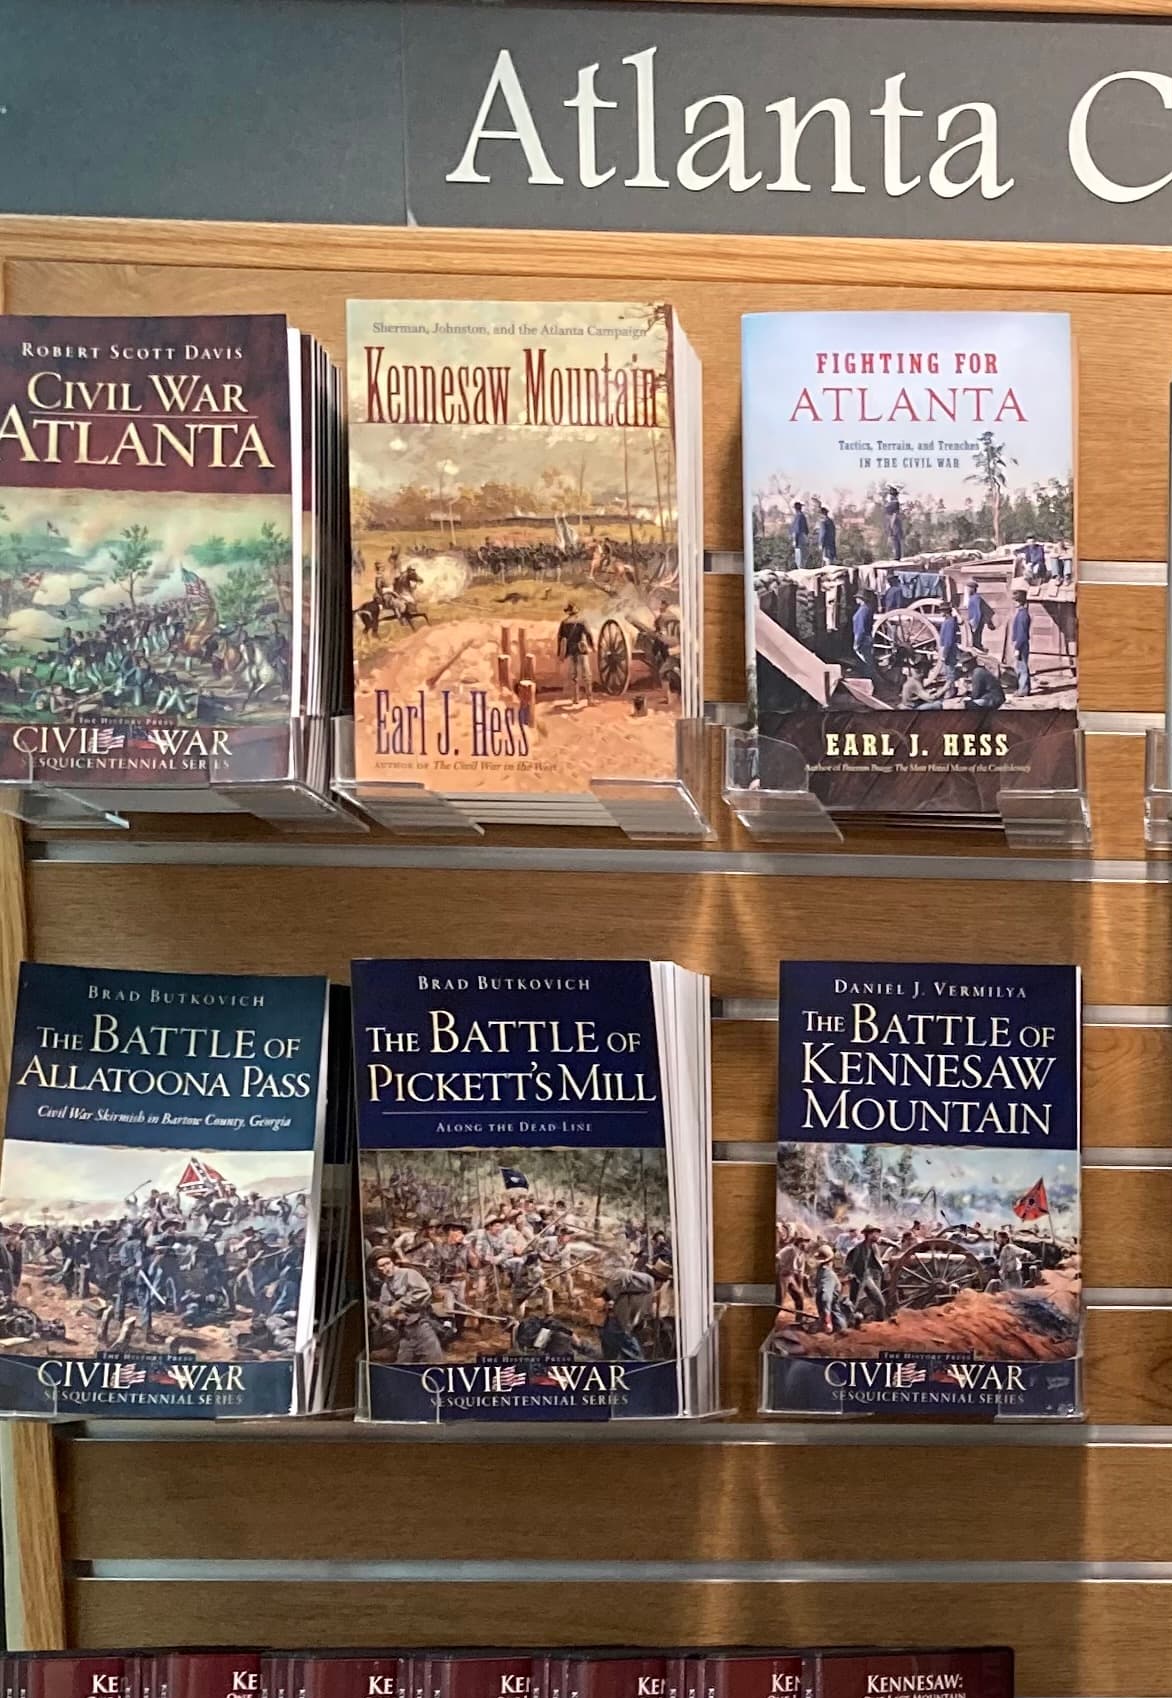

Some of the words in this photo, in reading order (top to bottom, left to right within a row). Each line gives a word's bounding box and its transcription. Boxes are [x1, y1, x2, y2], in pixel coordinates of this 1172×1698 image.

[446, 46, 1013, 199] Atlanta
[22, 342, 99, 359] ROBERT
[110, 344, 173, 359] SCOTT
[185, 345, 242, 359] DAVIS
[816, 353, 939, 374] FIGHTING
[955, 353, 998, 373] FOR
[27, 372, 142, 411] CIVIL
[149, 375, 248, 412] WAR
[365, 346, 511, 424] Kennesaw
[523, 349, 659, 428] Mountain
[789, 387, 1028, 423] ATLANTA
[0, 404, 275, 468] ATLANTA
[839, 440, 873, 452] Tactics,
[877, 441, 914, 452] Terrain,
[917, 441, 934, 450] and
[938, 440, 979, 451] Trenches
[375, 690, 427, 756] Earl
[438, 691, 458, 756] J.
[471, 691, 529, 756] Hess
[826, 734, 894, 756] EARL
[909, 734, 928, 757] J.
[944, 734, 1008, 756] HESS
[88, 985, 140, 1001] BRAD
[151, 990, 265, 1006] BUTKOVICH
[37, 1026, 83, 1050] THE
[90, 1014, 256, 1059] BATTLE
[264, 1038, 301, 1059] OF
[366, 1027, 420, 1052] THE
[429, 1010, 599, 1054] BATTLE
[607, 1032, 641, 1052] OF
[802, 1010, 846, 1032] THE
[850, 1003, 1011, 1048] BATTLE
[1019, 1026, 1056, 1048] OF
[16, 1054, 230, 1097] ALLATOONA
[241, 1066, 310, 1099] PASS
[367, 1061, 552, 1102] PICKETT'S
[558, 1063, 657, 1101] MILL
[801, 1042, 1056, 1090] KENNESAW
[801, 1088, 1052, 1135] MOUNTAIN
[867, 1674, 963, 1693] KENNESAW:
